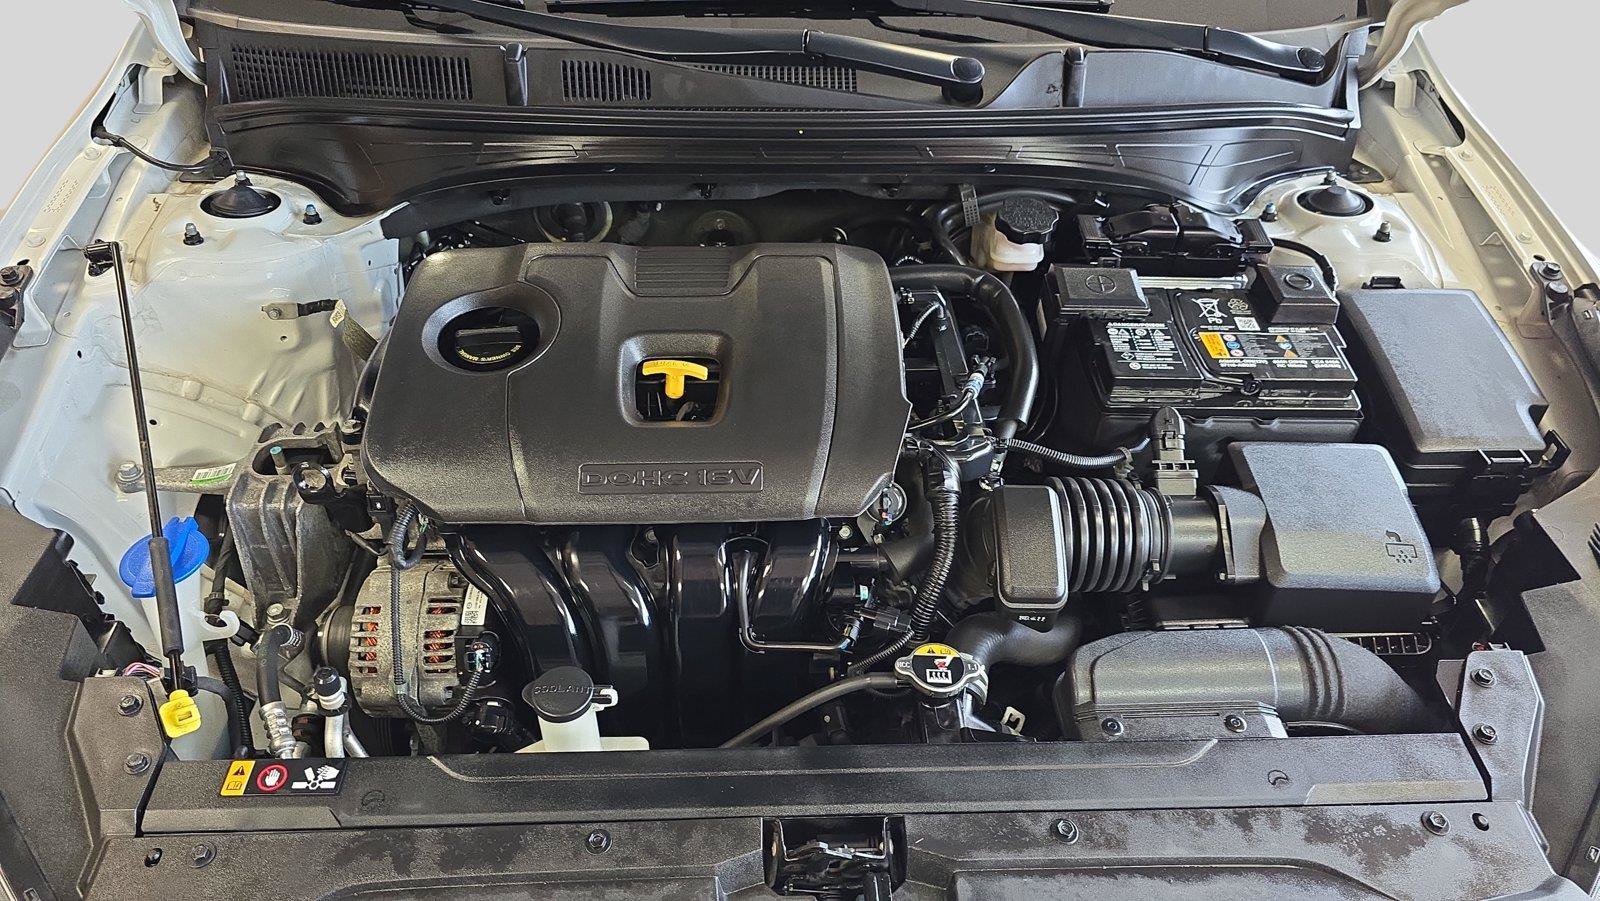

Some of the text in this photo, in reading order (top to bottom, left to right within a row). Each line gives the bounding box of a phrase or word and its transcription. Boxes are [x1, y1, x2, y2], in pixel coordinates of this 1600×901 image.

[582, 467, 761, 487] DOHC 16V
[967, 663, 978, 671] 1.1
[533, 684, 594, 695] COOLANT
